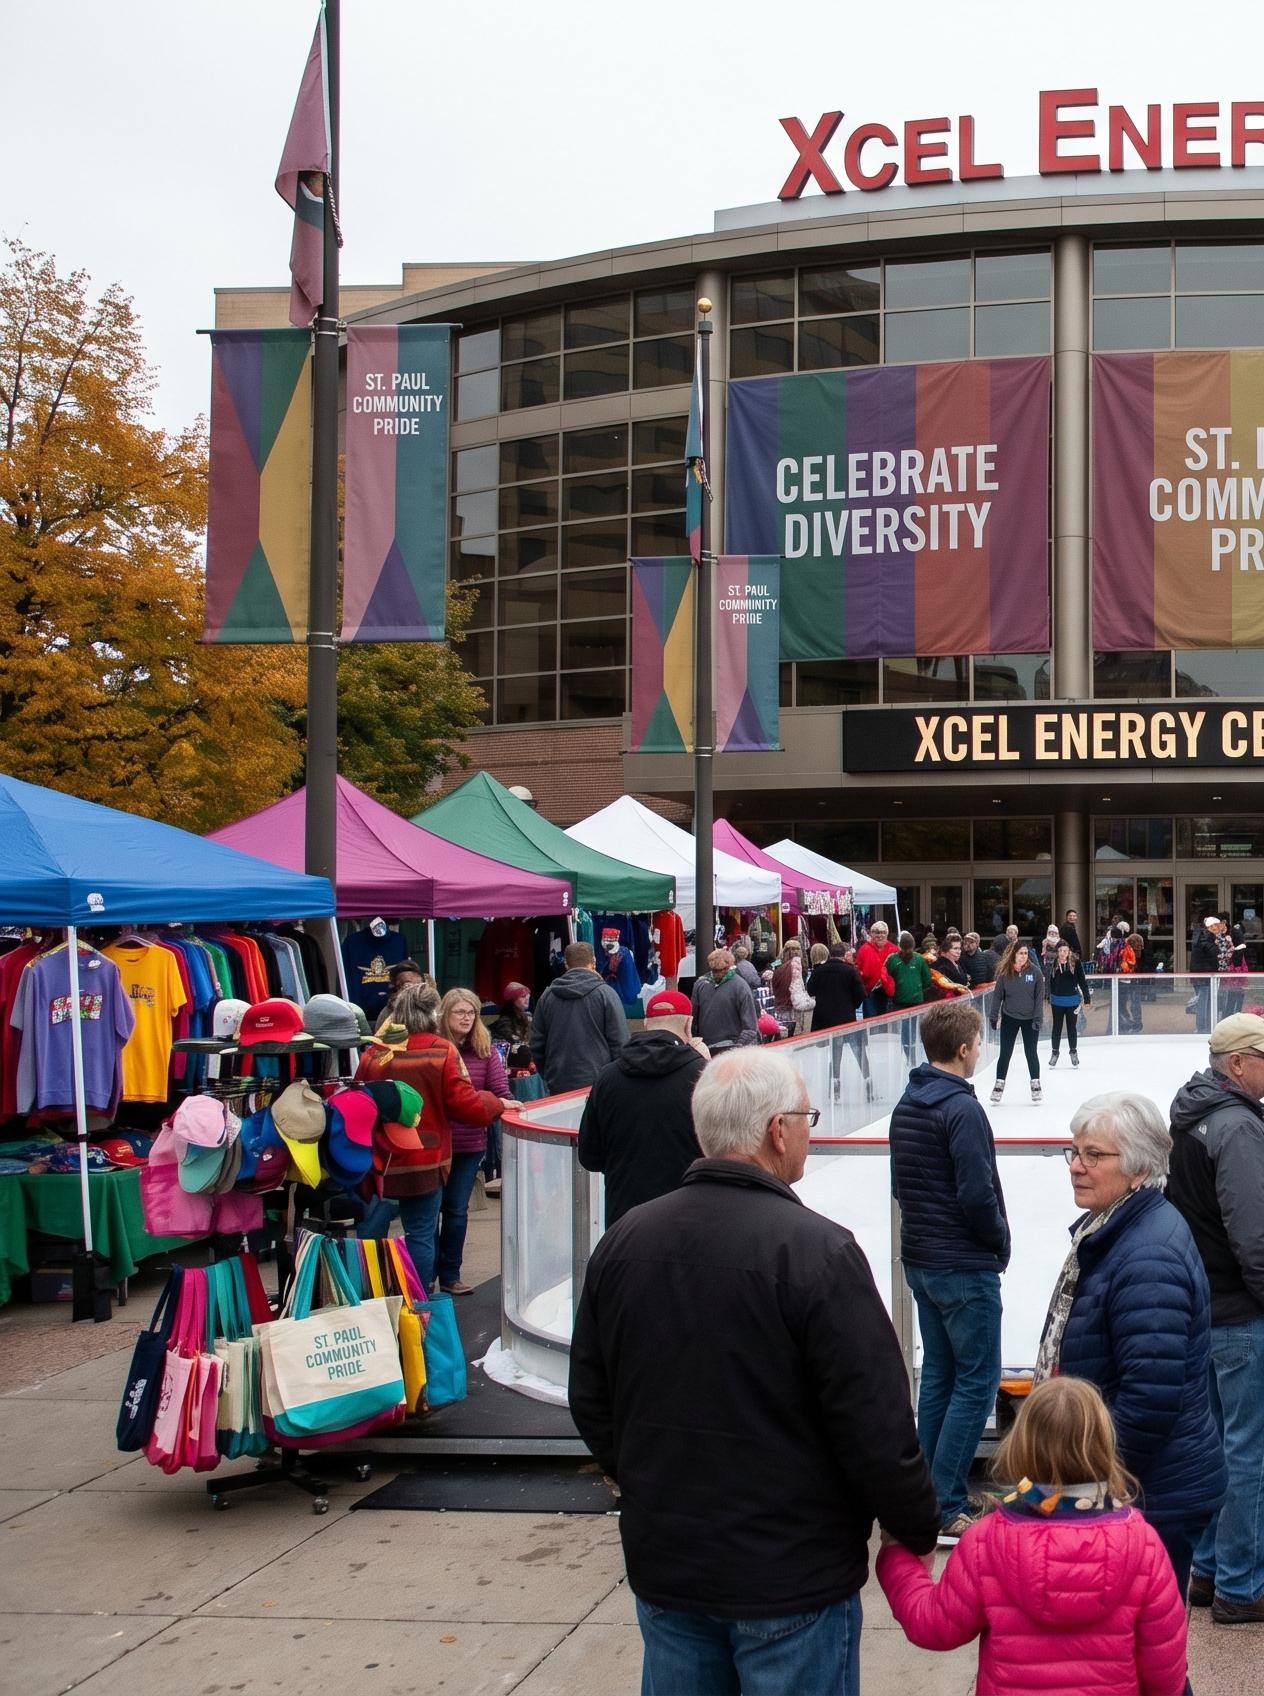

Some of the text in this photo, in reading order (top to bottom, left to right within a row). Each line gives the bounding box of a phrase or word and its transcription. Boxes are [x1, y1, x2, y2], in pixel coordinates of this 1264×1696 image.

[777, 110, 1004, 200] XCEL
[365, 372, 430, 390] ST. PAUL
[353, 394, 443, 413] COMMUNITY
[373, 417, 420, 435] PRIDE
[1184, 426, 1240, 471] ST.
[776, 444, 999, 504] CELEBRATE
[784, 501, 992, 559] DIVERSITY
[744, 584, 770, 596] PAUL
[914, 714, 1020, 763] XCEL
[1035, 711, 1207, 760] ENERGY
[313, 1326, 366, 1350] ST. PAUL
[305, 1338, 377, 1369] COMMUNITY
[327, 1359, 367, 1381] PRIDE
